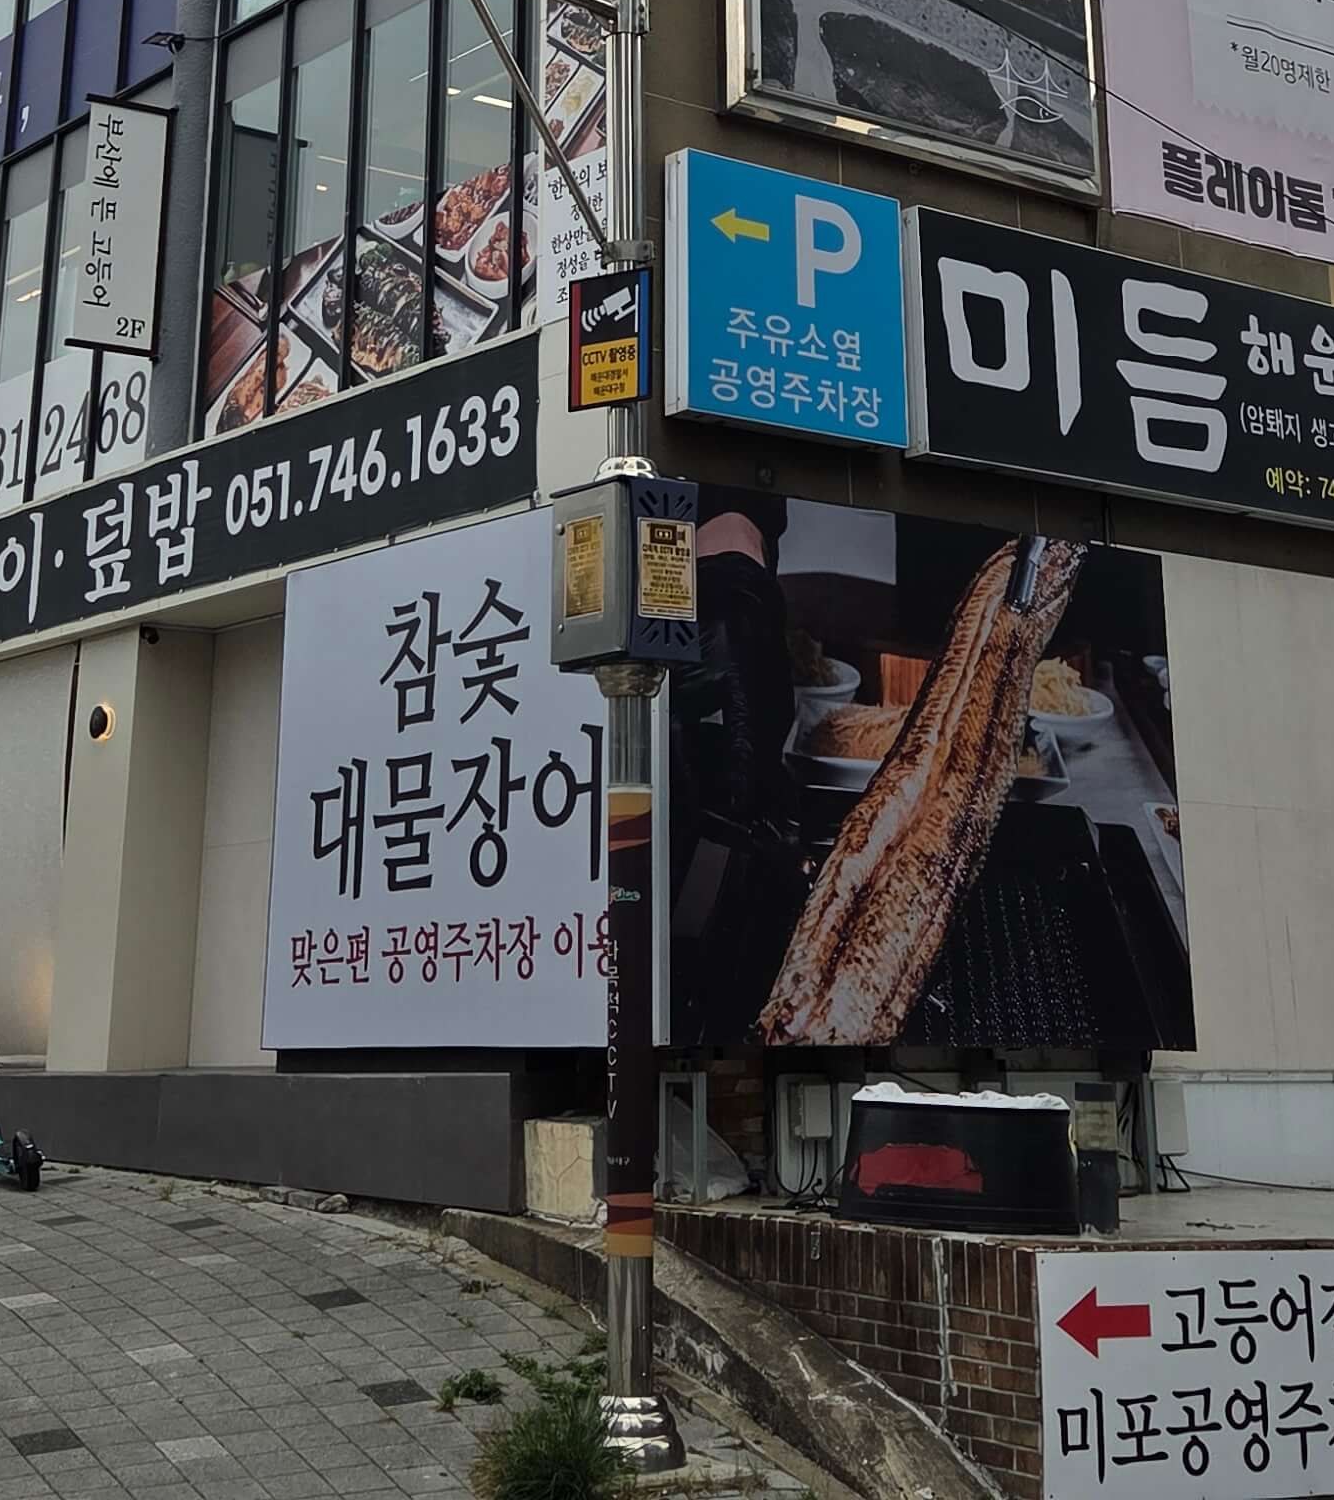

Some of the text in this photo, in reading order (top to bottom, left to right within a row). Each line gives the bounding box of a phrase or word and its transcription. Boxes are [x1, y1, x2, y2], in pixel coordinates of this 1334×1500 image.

[93, 113, 124, 189] 부산에
[1162, 140, 1326, 233] 플레이돔
[83, 231, 112, 308] 고등어
[795, 194, 863, 308] P
[116, 316, 146, 339] 2F
[583, 350, 607, 366] CCTV
[726, 307, 862, 371] 주유소옆
[938, 257, 1227, 472] 미듬
[709, 358, 882, 429] 공영주차장
[225, 384, 522, 537] 051.746.1633
[1266, 467, 1310, 498] 예약:
[379, 579, 530, 733] 참숯
[310, 724, 604, 899] 대물장어
[291, 924, 370, 988] 맞은편
[381, 913, 541, 985] 공영주차장
